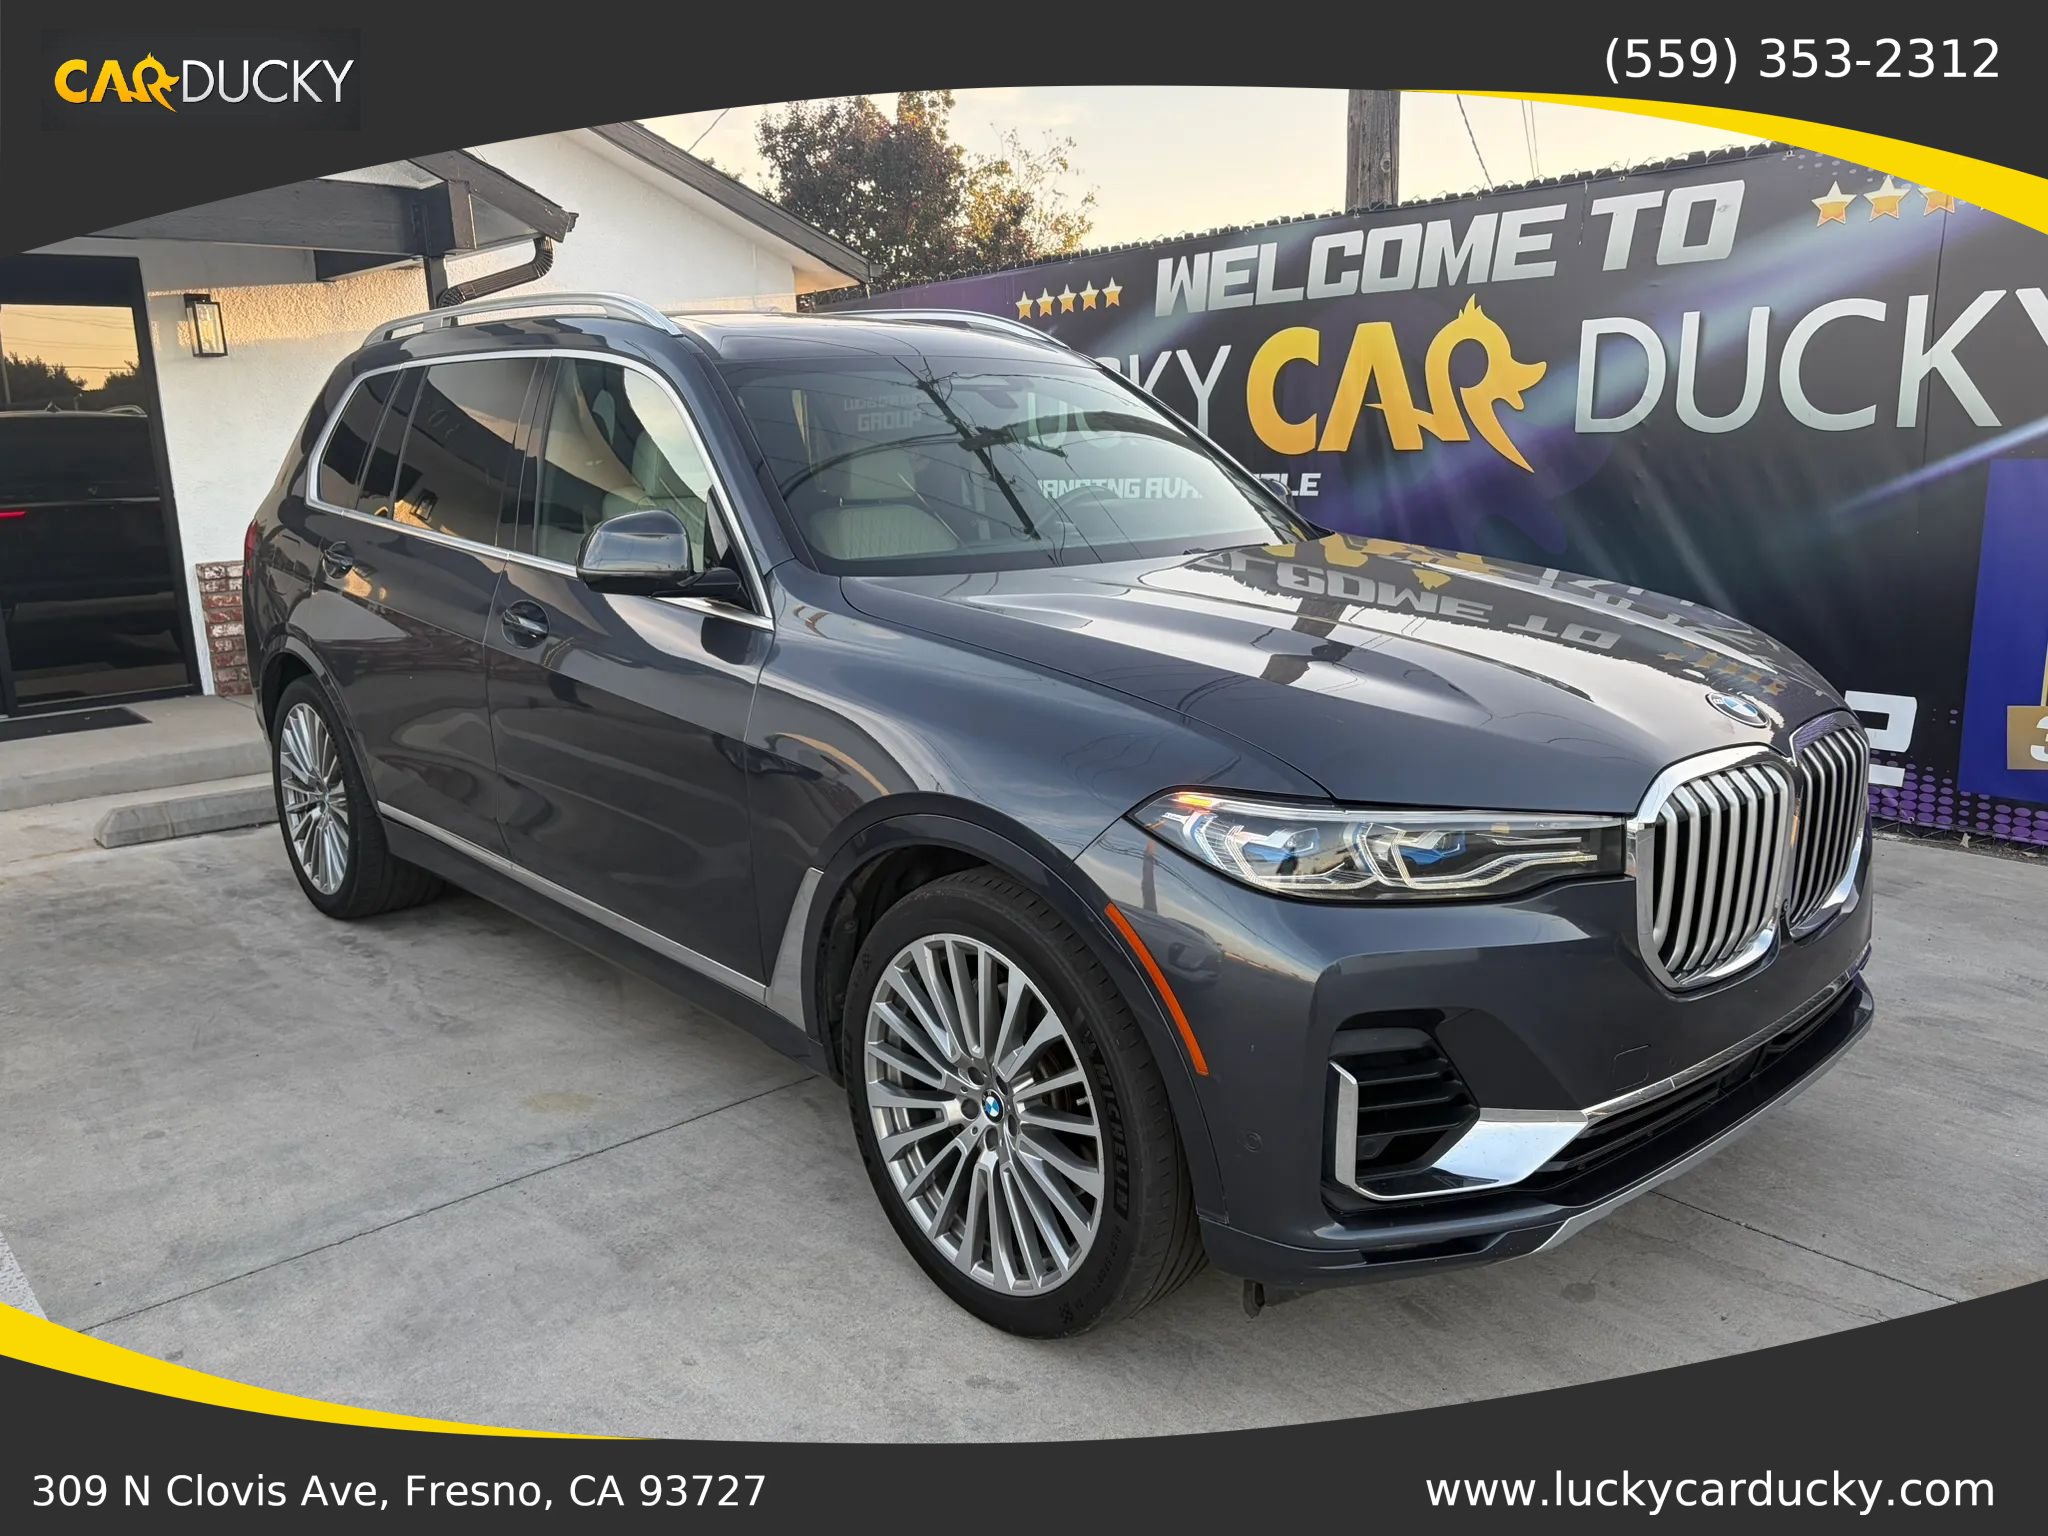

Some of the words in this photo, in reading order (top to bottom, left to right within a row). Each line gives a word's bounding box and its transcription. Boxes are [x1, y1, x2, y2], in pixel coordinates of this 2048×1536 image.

[1155, 203, 1567, 317] WELCOME
[1591, 180, 1745, 271] TO
[1247, 293, 1547, 473] CAR
[1096, 1060, 1130, 1217] MICHELIN
